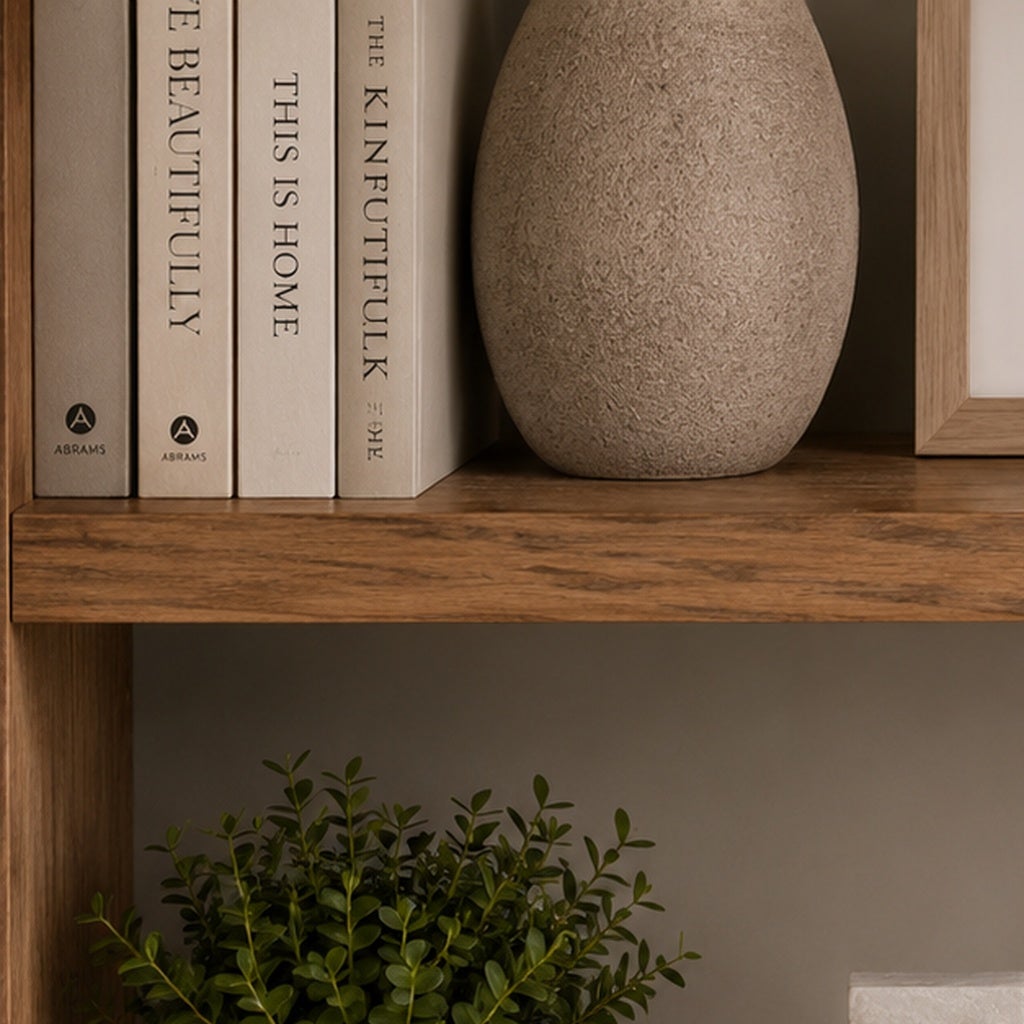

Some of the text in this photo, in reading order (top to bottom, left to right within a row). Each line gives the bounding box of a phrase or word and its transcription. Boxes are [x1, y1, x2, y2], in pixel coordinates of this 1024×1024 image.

[367, 15, 385, 67] THE
[168, 0, 201, 336] E BEAUTIFULLY
[272, 71, 300, 338] THIS IS HOME
[54, 444, 106, 456] ABRAMS
[161, 452, 207, 462] ABRAMS
